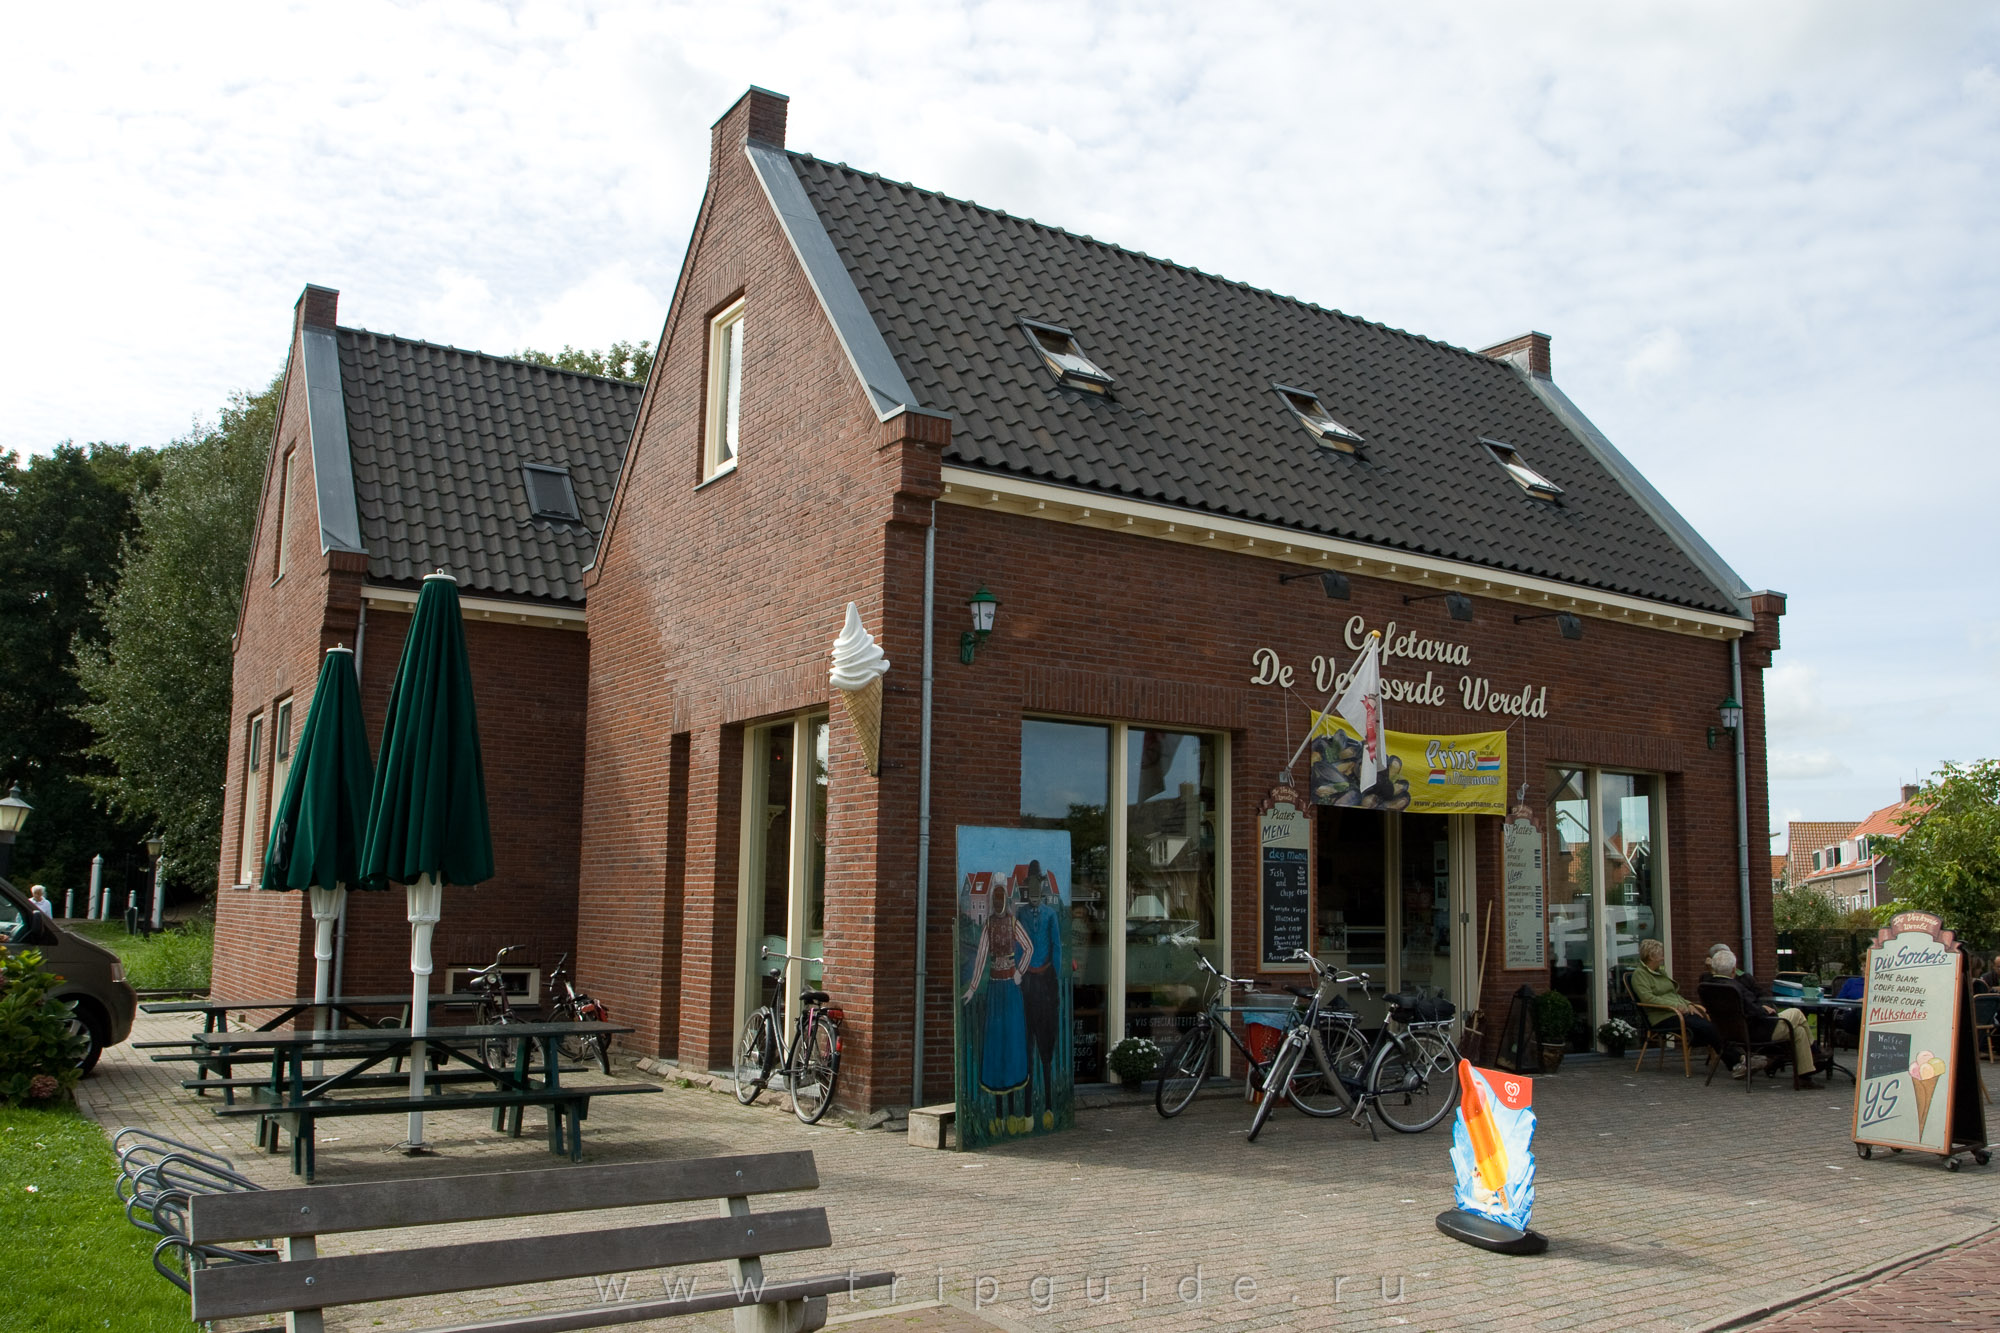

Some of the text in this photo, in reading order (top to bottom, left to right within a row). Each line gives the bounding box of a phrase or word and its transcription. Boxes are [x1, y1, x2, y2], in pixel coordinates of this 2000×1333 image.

[1344, 615, 1471, 666] Cafetaria
[1250, 647, 1548, 719] De Veeerde Wereld
[1425, 740, 1477, 771] Prins
[1262, 824, 1291, 841] MENU
[1269, 868, 1284, 877] Fish
[1275, 877, 1287, 887] and
[1895, 945, 1948, 967] Sorbets
[1874, 972, 1919, 984] DAME BLANC
[1873, 983, 1926, 995] COUPE AARDBEI
[1872, 995, 1926, 1007] KINDER COUPE
[1869, 1007, 1928, 1022] Milkshakes
[1507, 1096, 1517, 1104] OLA
